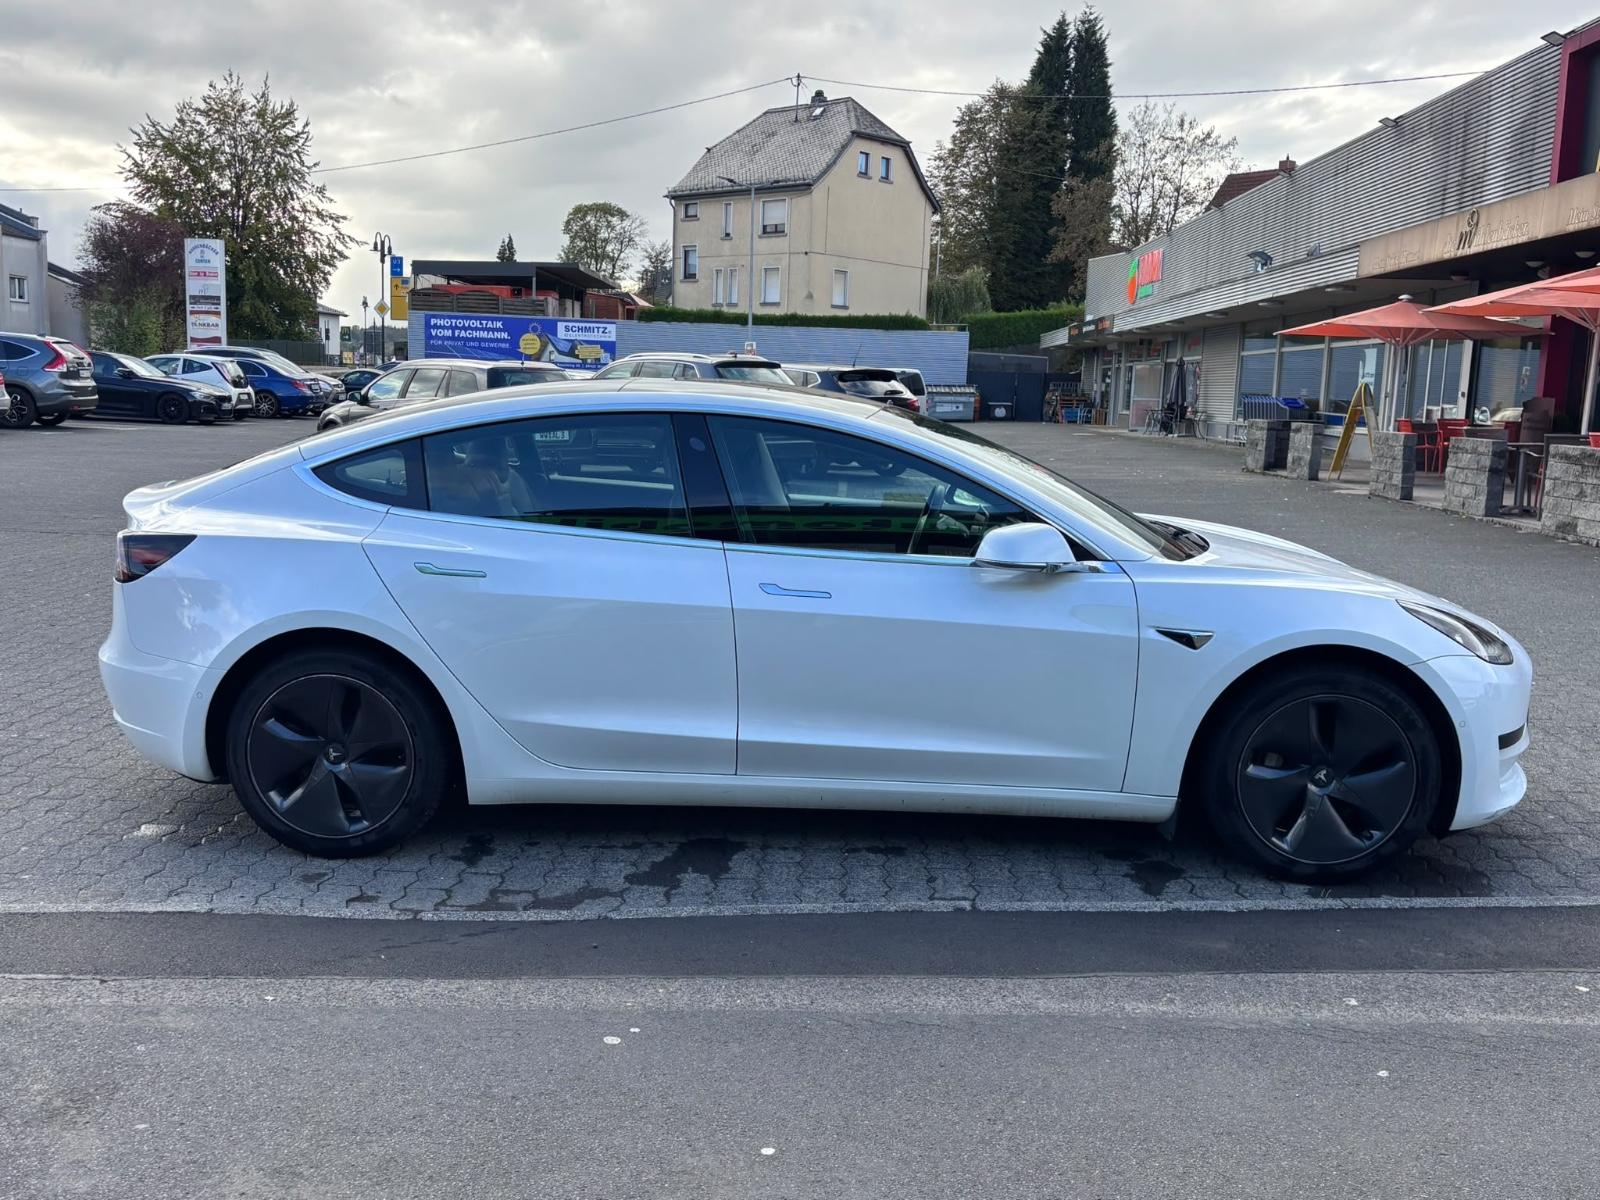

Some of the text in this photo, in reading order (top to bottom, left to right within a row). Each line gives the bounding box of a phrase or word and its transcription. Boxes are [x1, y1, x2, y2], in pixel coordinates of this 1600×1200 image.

[430, 318, 503, 329] PHOTOVOLTAIK
[430, 329, 511, 340] VOM FACHMANN.
[564, 325, 608, 334] SCHMITZ
